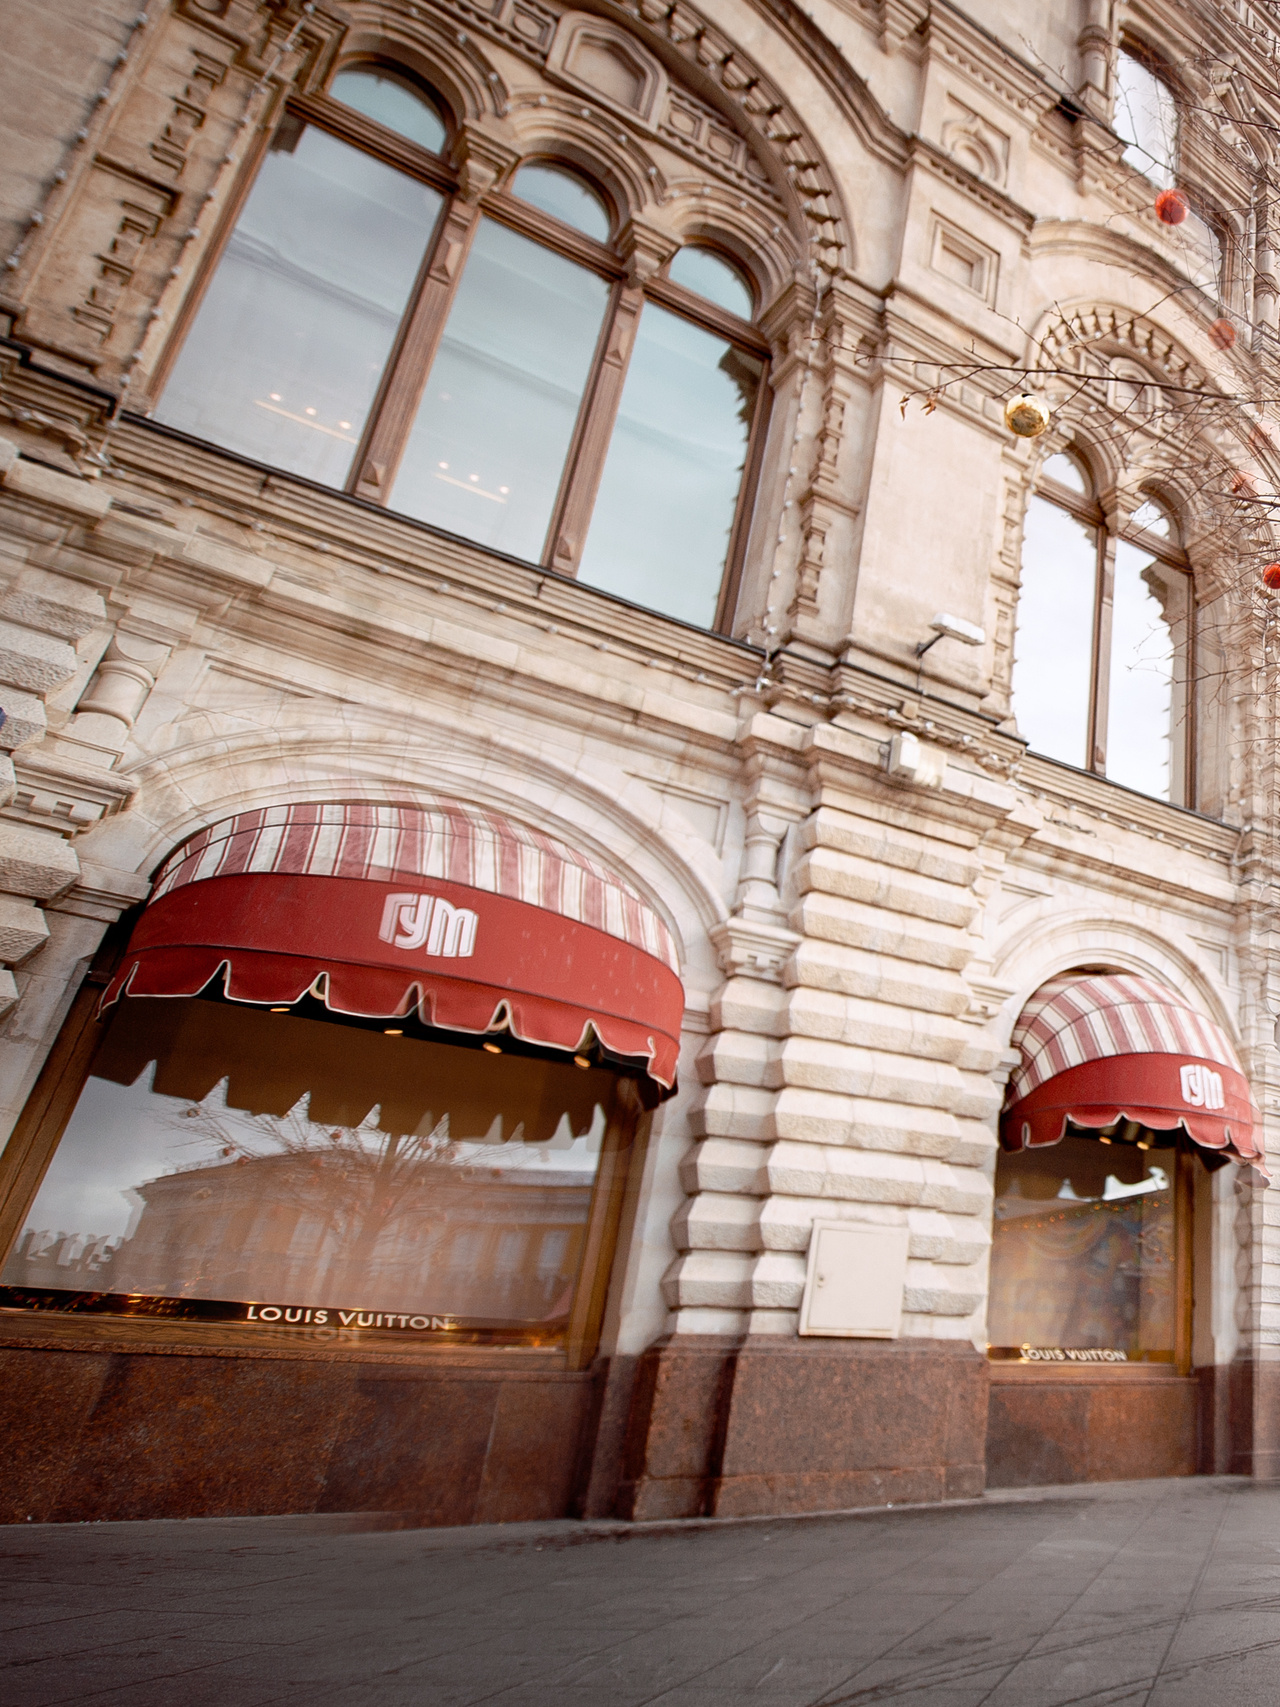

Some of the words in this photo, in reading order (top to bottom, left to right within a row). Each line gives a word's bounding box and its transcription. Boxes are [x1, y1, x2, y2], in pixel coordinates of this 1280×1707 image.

[246, 1305, 329, 1325] LOUIS
[338, 1310, 450, 1331] VUITTON
[1020, 1348, 1066, 1361] LOUIS
[1065, 1348, 1128, 1361] VUITTON
